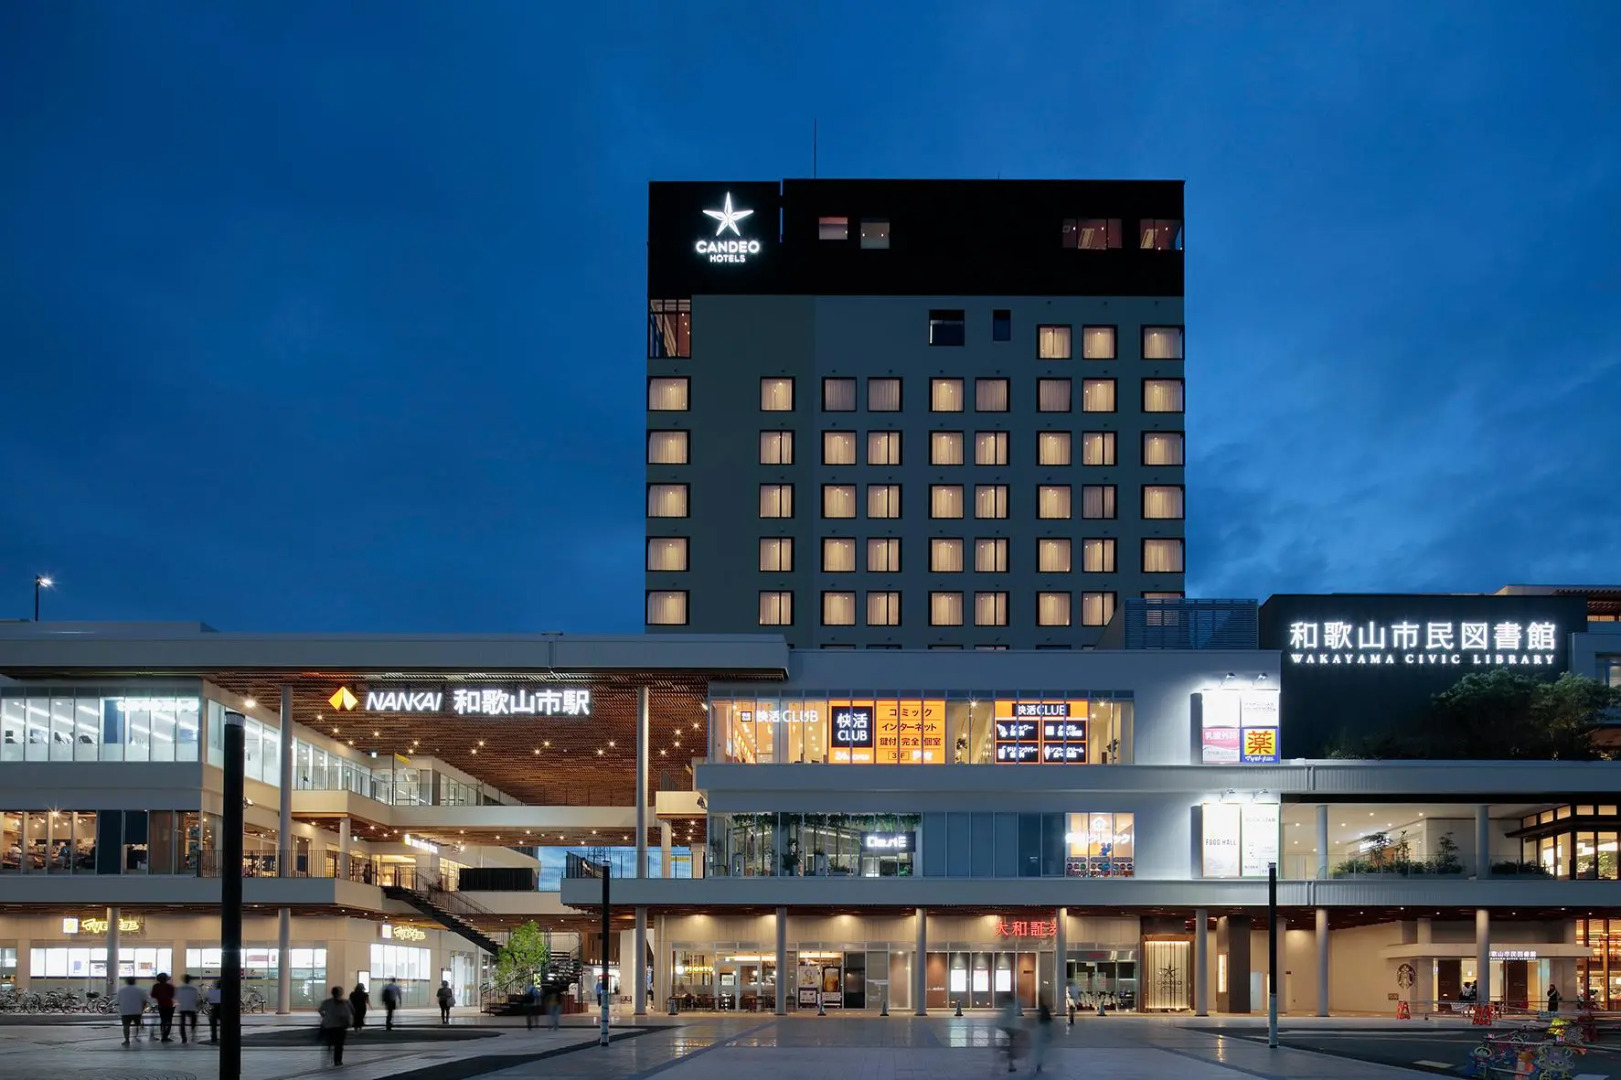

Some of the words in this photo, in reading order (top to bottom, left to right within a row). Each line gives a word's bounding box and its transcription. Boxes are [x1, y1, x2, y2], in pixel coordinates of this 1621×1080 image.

[695, 240, 761, 254] CANDEO
[709, 254, 746, 263] HOTELS
[1290, 621, 1556, 650] 和歌山市民図書館
[1290, 653, 1395, 665] WAKAYAMA
[1404, 653, 1461, 665] CIVIC
[1472, 653, 1556, 665] LIBRARY
[365, 691, 443, 711] NANKAI
[453, 688, 590, 716] 和歌山市駅
[888, 708, 933, 717] コミック
[837, 713, 868, 729] 快活
[881, 722, 937, 732] インターネット
[837, 729, 868, 742] CLUB
[1248, 730, 1272, 754] 薬
[1205, 838, 1221, 846] FOOD
[1221, 838, 1237, 846] HALL
